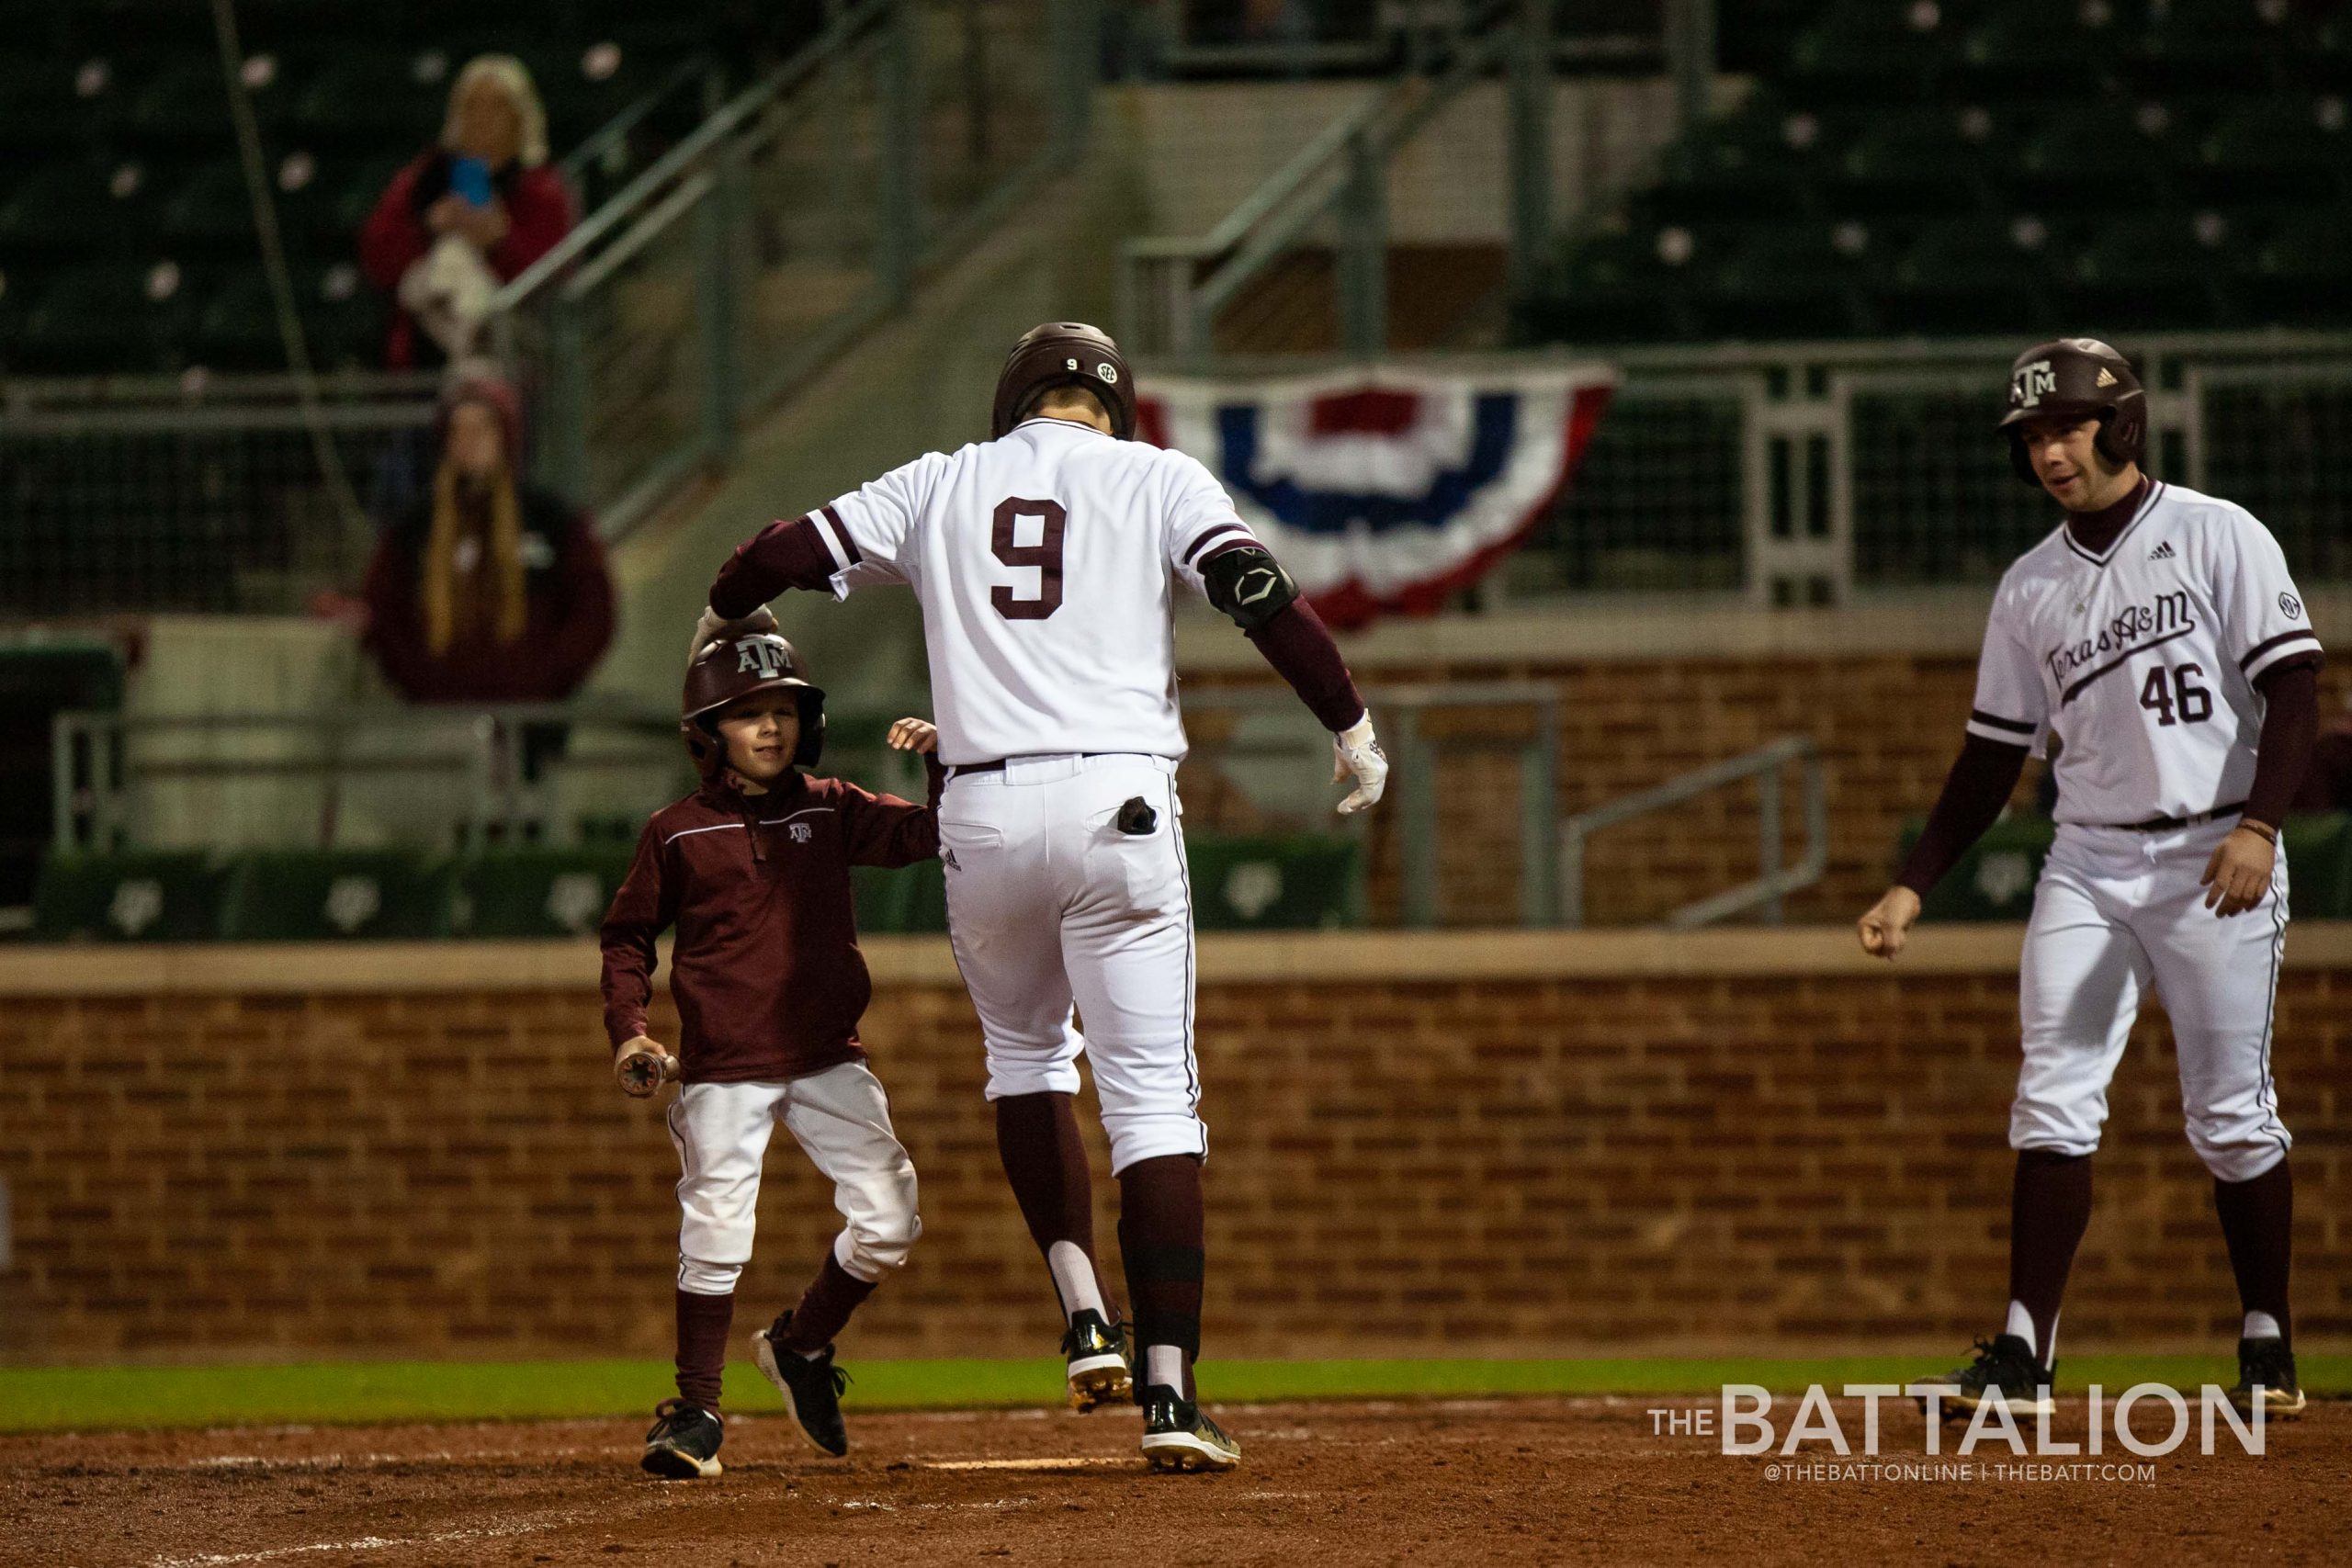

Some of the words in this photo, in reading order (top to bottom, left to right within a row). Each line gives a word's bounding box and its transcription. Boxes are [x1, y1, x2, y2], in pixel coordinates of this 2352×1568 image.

[1067, 358, 1078, 370] 9
[1101, 366, 1115, 381] SEC
[991, 496, 1067, 620] 9
[736, 638, 793, 679] ATM
[2046, 630, 2112, 689] Texas
[2113, 591, 2195, 650] A&M
[2140, 662, 2213, 727] 46
